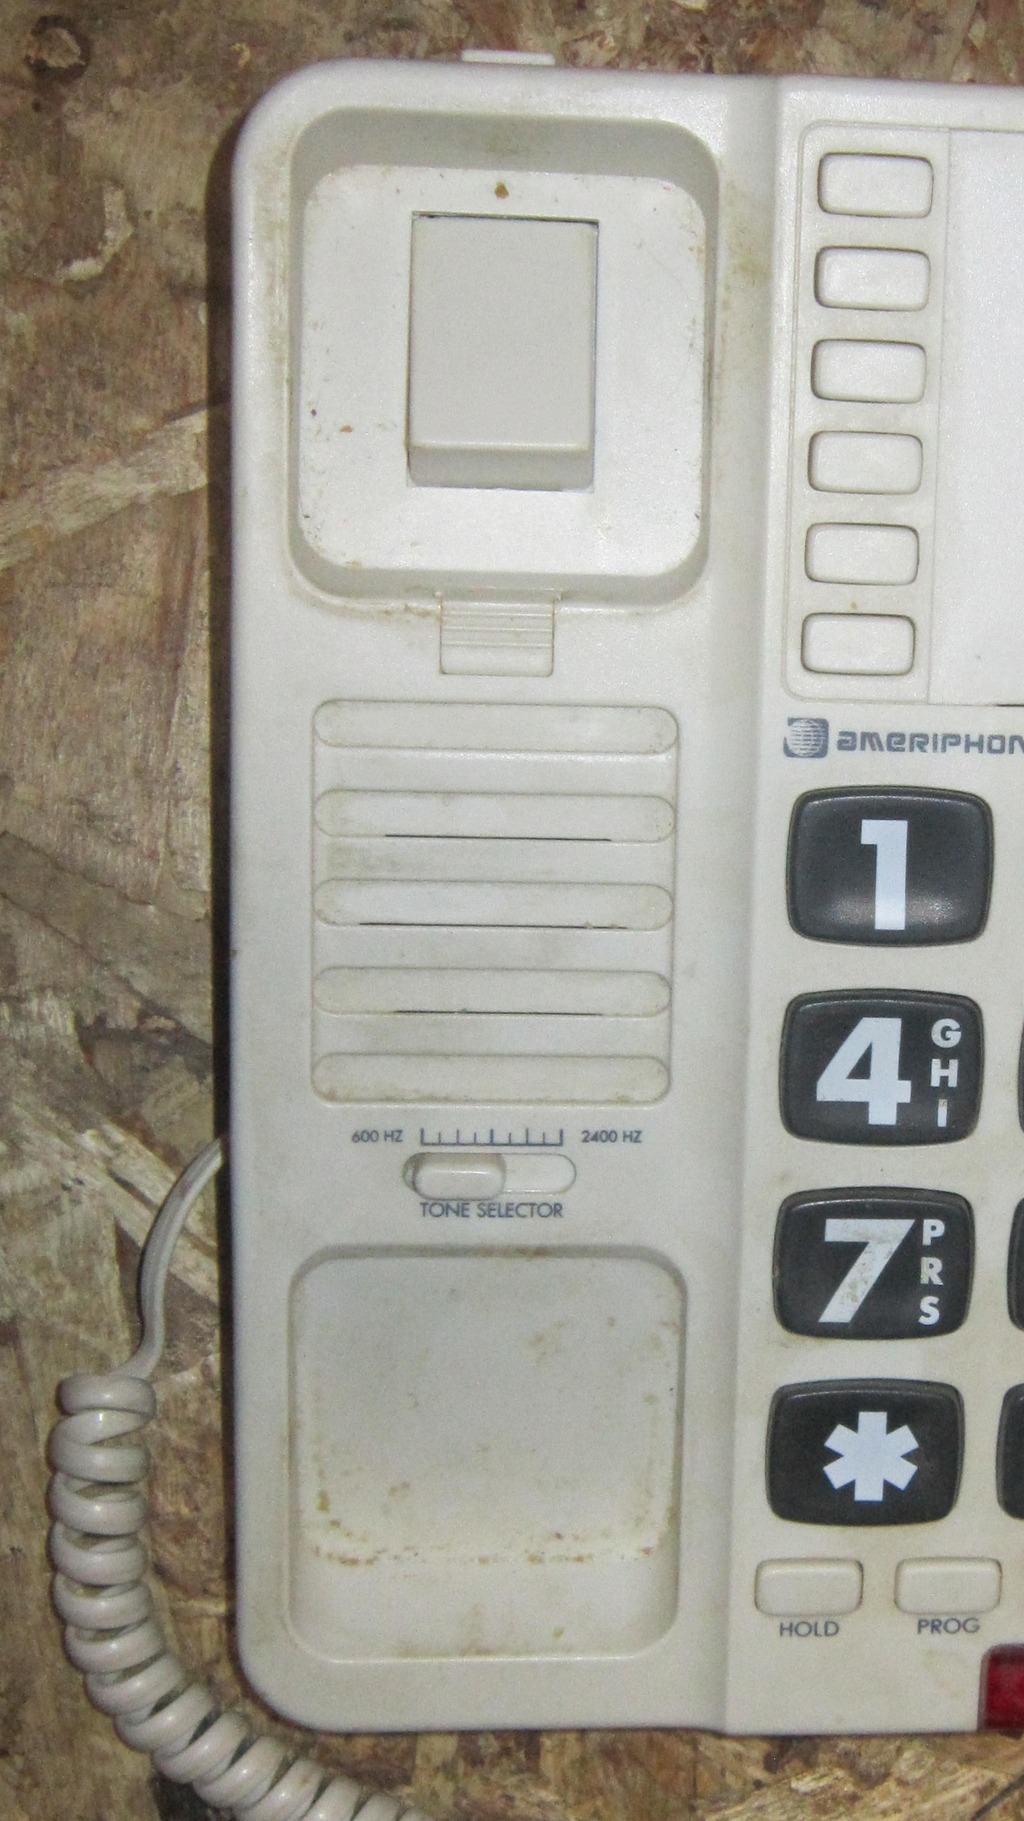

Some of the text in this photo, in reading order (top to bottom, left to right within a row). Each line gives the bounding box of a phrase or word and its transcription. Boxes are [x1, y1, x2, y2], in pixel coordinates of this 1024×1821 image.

[859, 819, 909, 931] 1
[816, 1016, 912, 1126] 4
[351, 1129, 403, 1143] 600 HZ
[581, 1129, 642, 1144] 2400 HZ
[420, 1202, 563, 1218] TONE SELECTOR
[818, 1218, 916, 1323] 7
[779, 1620, 840, 1637] HOLD
[917, 1617, 980, 1634] PROG
